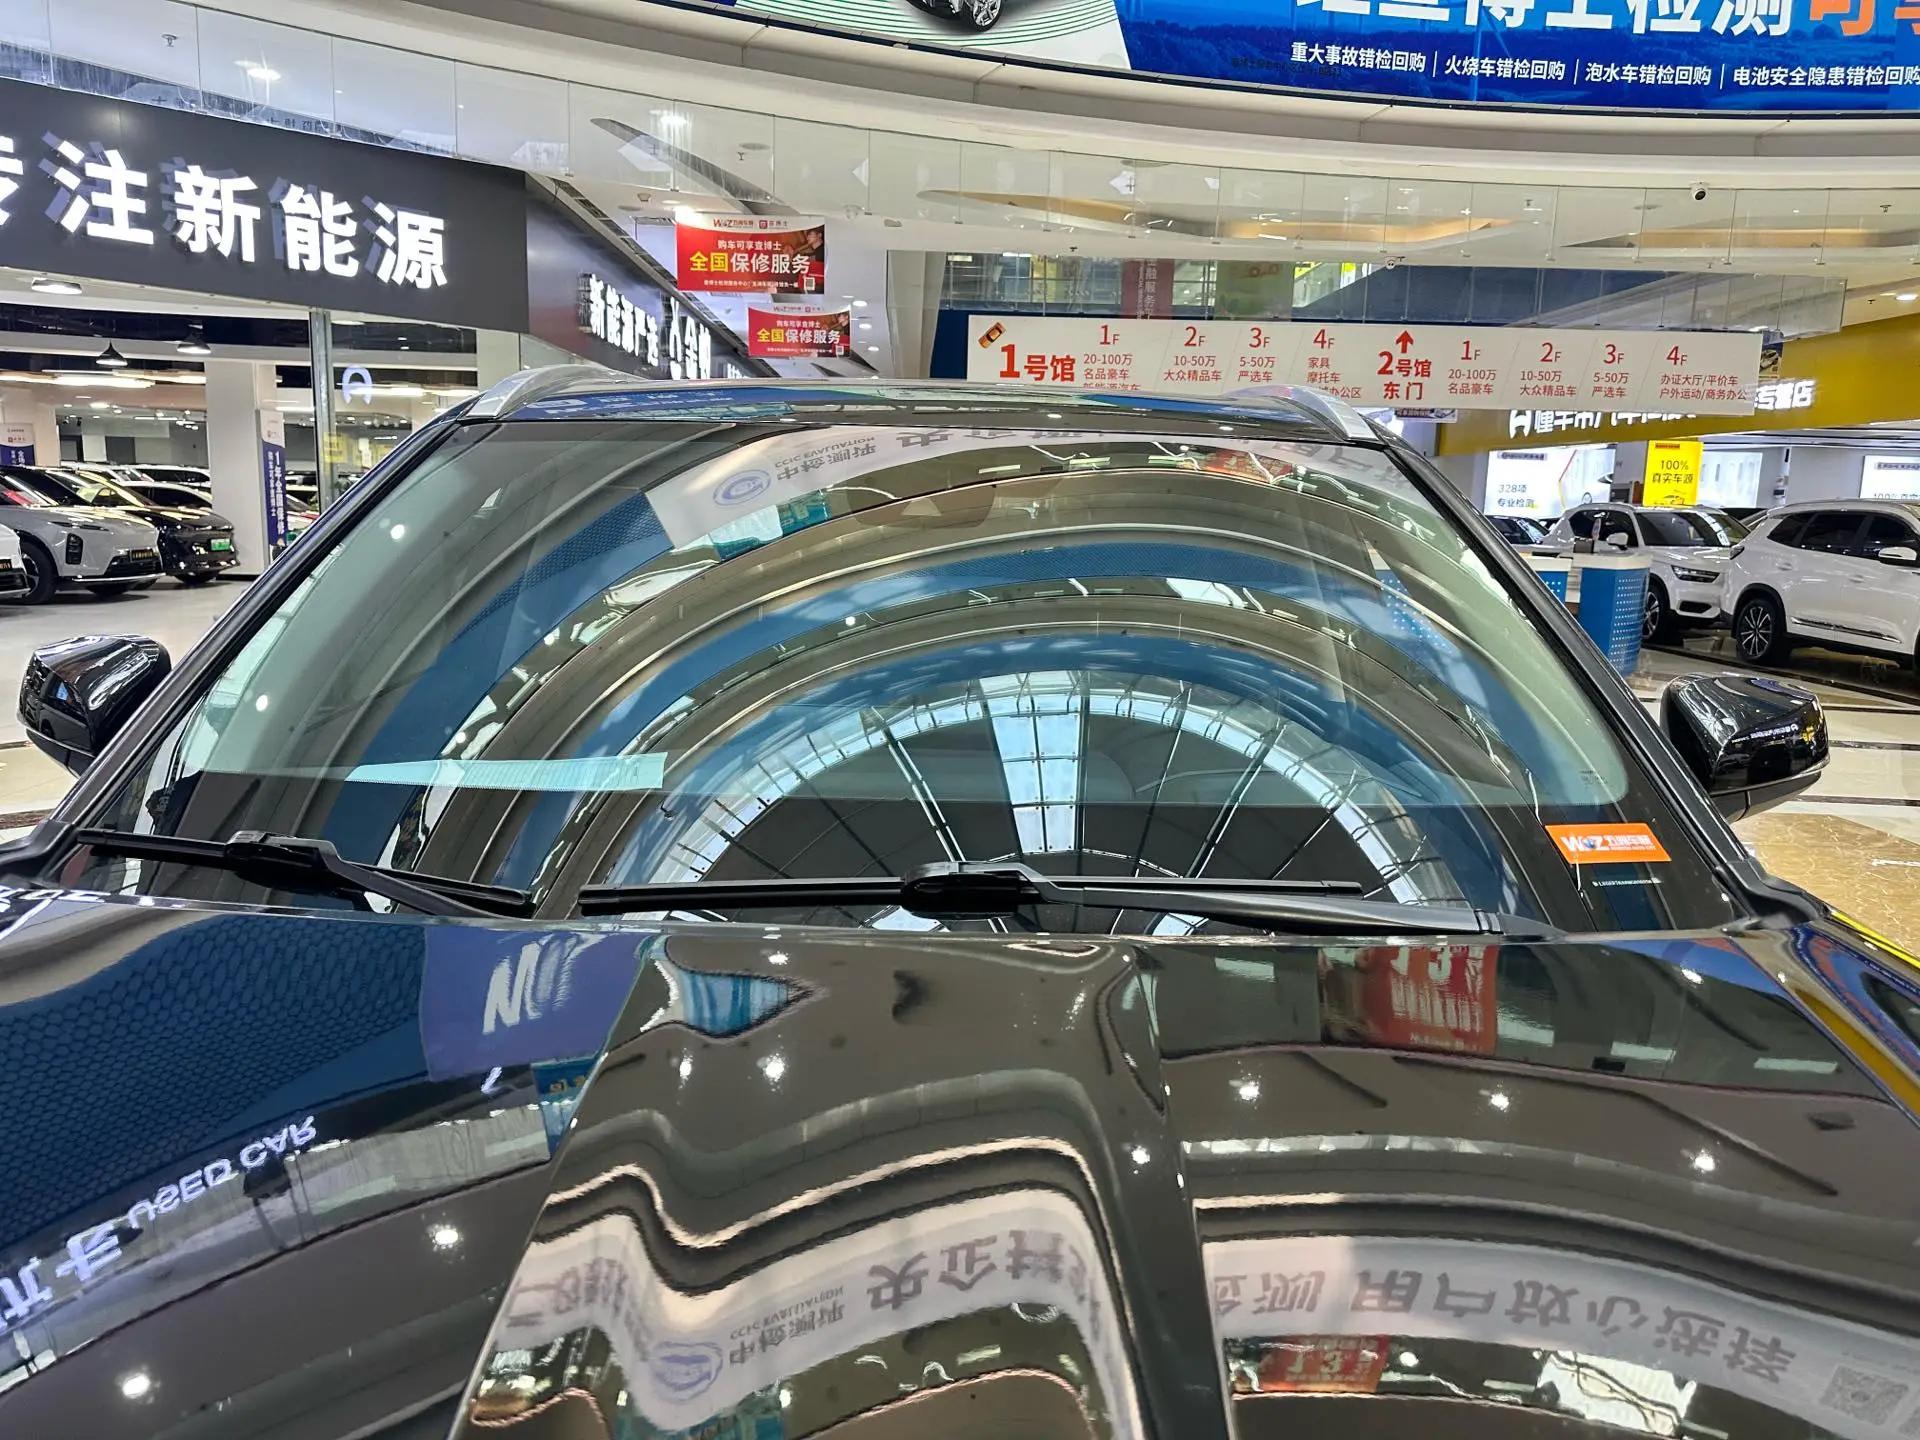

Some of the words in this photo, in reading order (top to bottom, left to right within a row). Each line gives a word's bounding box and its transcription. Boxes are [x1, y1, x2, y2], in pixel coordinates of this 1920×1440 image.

[1290, 41, 1427, 73] 重大事故错检回购
[1444, 54, 1566, 81] 火烧车错检回购
[1585, 62, 1712, 87] 泡水车错检回购
[1732, 65, 1920, 88] 电池安全隐患错检回购
[690, 251, 811, 274] 全国保修服务
[756, 328, 841, 345] 全国保修服务
[1099, 324, 1120, 345] 1F
[1184, 326, 1206, 347] 2F
[1249, 327, 1271, 348] 3F
[1313, 328, 1335, 349] 4F
[1460, 340, 1481, 361] 1F
[1539, 342, 1561, 363] 2F
[1603, 343, 1624, 365] 3F
[1666, 345, 1688, 366] 4F
[999, 343, 1076, 382] 1号馆
[1083, 353, 1133, 366] 20-100万
[1173, 355, 1217, 368] 10-50万
[1239, 356, 1276, 368] 5-50万
[1308, 357, 1330, 369] 家具
[1377, 350, 1432, 378] 2号馆
[1083, 368, 1130, 380] 名品豪车
[1163, 370, 1222, 382] 大众精品车
[1237, 371, 1273, 383] 严选车
[1306, 371, 1341, 384] 摩托车
[1448, 368, 1497, 381] 20-100万
[1520, 370, 1562, 382] 10-50万
[1593, 371, 1629, 384] 5-50万
[1660, 373, 1739, 387] 办证大厅/平价车
[1383, 381, 1424, 400] 东门
[1447, 383, 1494, 395] 名品豪车
[1519, 384, 1577, 397] 大众精品车
[1591, 385, 1627, 398] 严选车
[1659, 388, 1747, 401] 户外运动/商务办公
[1660, 460, 1689, 470] 100%
[1652, 473, 1694, 484] 真实车源
